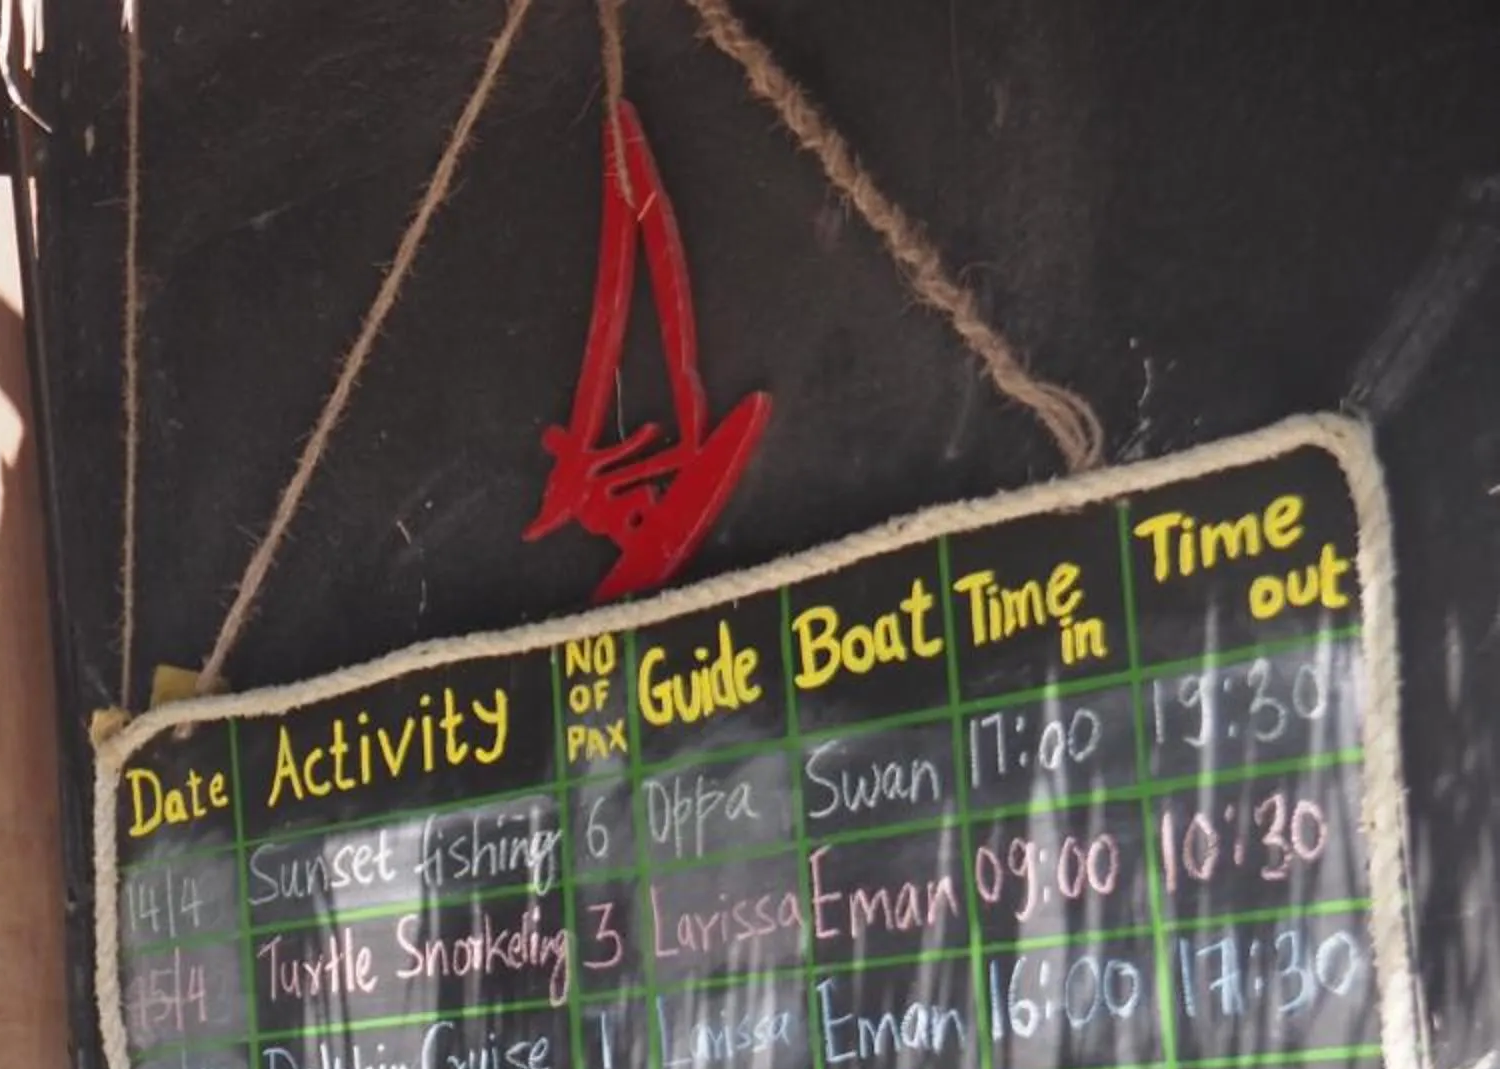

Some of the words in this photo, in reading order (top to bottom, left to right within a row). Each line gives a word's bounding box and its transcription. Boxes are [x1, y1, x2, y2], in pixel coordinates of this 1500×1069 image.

[1135, 495, 1304, 583] Time
[1249, 543, 1350, 620] out
[793, 578, 943, 690] Boat
[954, 562, 1084, 647] Time
[1060, 616, 1109, 665] in
[566, 633, 616, 677] NO
[570, 680, 610, 713] OF
[638, 619, 762, 726] Guide
[268, 688, 509, 806] Activity
[567, 720, 627, 763] PAX
[126, 863, 204, 938] 14/4
[249, 827, 396, 905] Sunset
[414, 804, 562, 895] fishing
[586, 796, 609, 859] 6
[805, 739, 941, 819] Swan
[970, 707, 1100, 788] 17:00
[1153, 656, 1329, 747] 19:30
[127, 769, 228, 837] Date
[259, 928, 378, 1001] Turtle
[396, 907, 574, 1008] Snorkeling
[584, 902, 624, 970] 3
[650, 883, 802, 958] Larissa
[810, 845, 958, 940] Eman
[977, 834, 1119, 921] 09:00
[1161, 794, 1327, 893] 10:30
[657, 996, 793, 1068] Larissa
[817, 977, 966, 1063] Eman
[989, 955, 1140, 1041] 16:00
[1179, 930, 1364, 1018] 17:30
